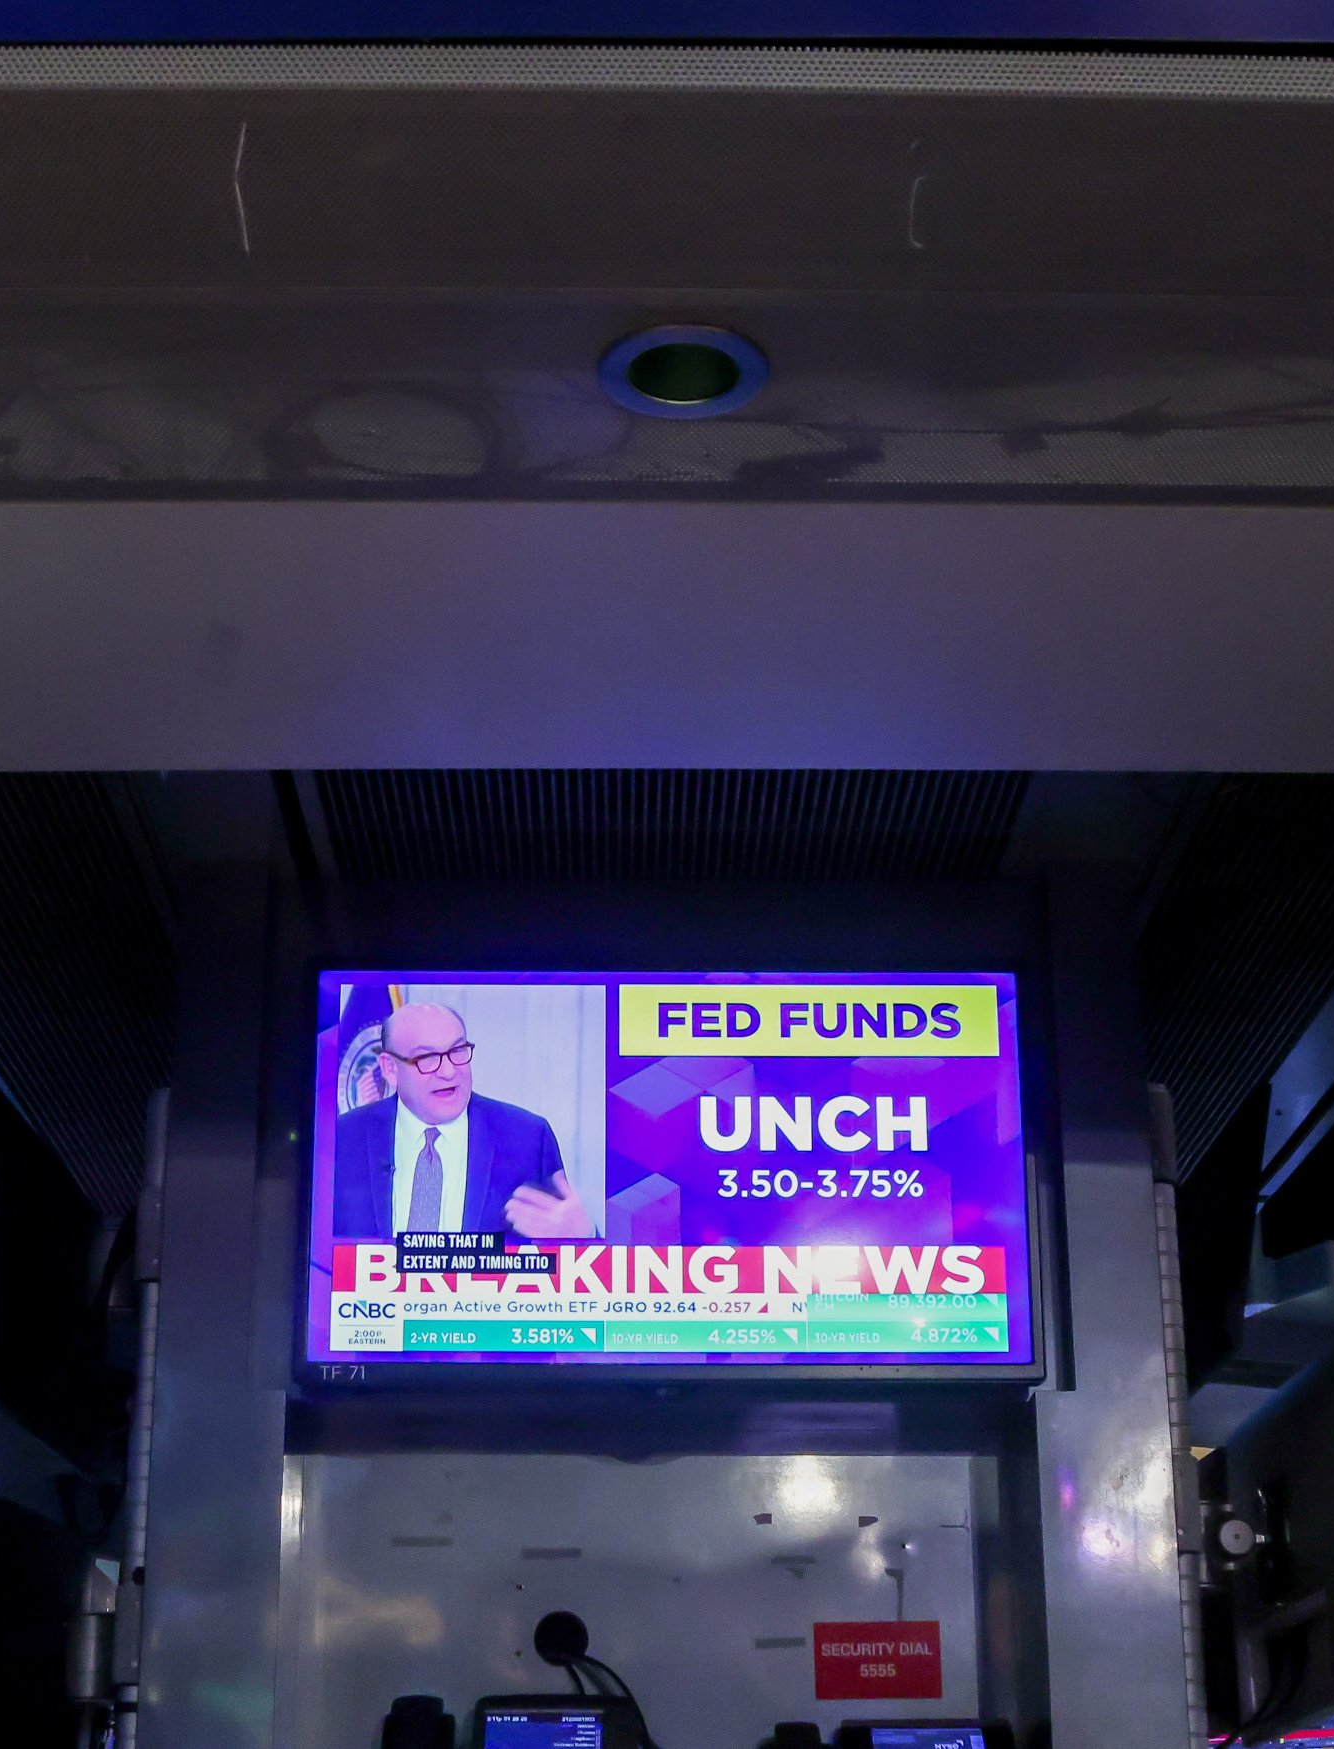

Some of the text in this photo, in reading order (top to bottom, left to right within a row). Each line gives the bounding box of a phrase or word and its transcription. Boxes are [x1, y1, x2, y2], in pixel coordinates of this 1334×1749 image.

[657, 1002, 961, 1039] FED FUNDS
[699, 1095, 928, 1152] UNCH
[717, 1169, 924, 1198] 3.50-3.75%
[403, 1234, 494, 1248] SAYING THAT IN
[403, 1255, 549, 1269] EXTENT AND TIMING ITIO
[763, 1245, 986, 1294] NEWS
[814, 1293, 869, 1303] BITCOIN
[338, 1300, 396, 1319] CNBC
[403, 1300, 807, 1315] organ Active Growth ETF JGRO 92.64 -0.257 N
[410, 1328, 574, 1345] 2-YR YIELD 3.581%
[612, 1328, 777, 1344] 10-YR YIELD 4.255%
[814, 1327, 978, 1343] 30-YR YIELD 4.872%
[320, 1365, 366, 1379] TF 71
[821, 1642, 933, 1657] SECURITY DIAL
[860, 1663, 896, 1678] 5555
